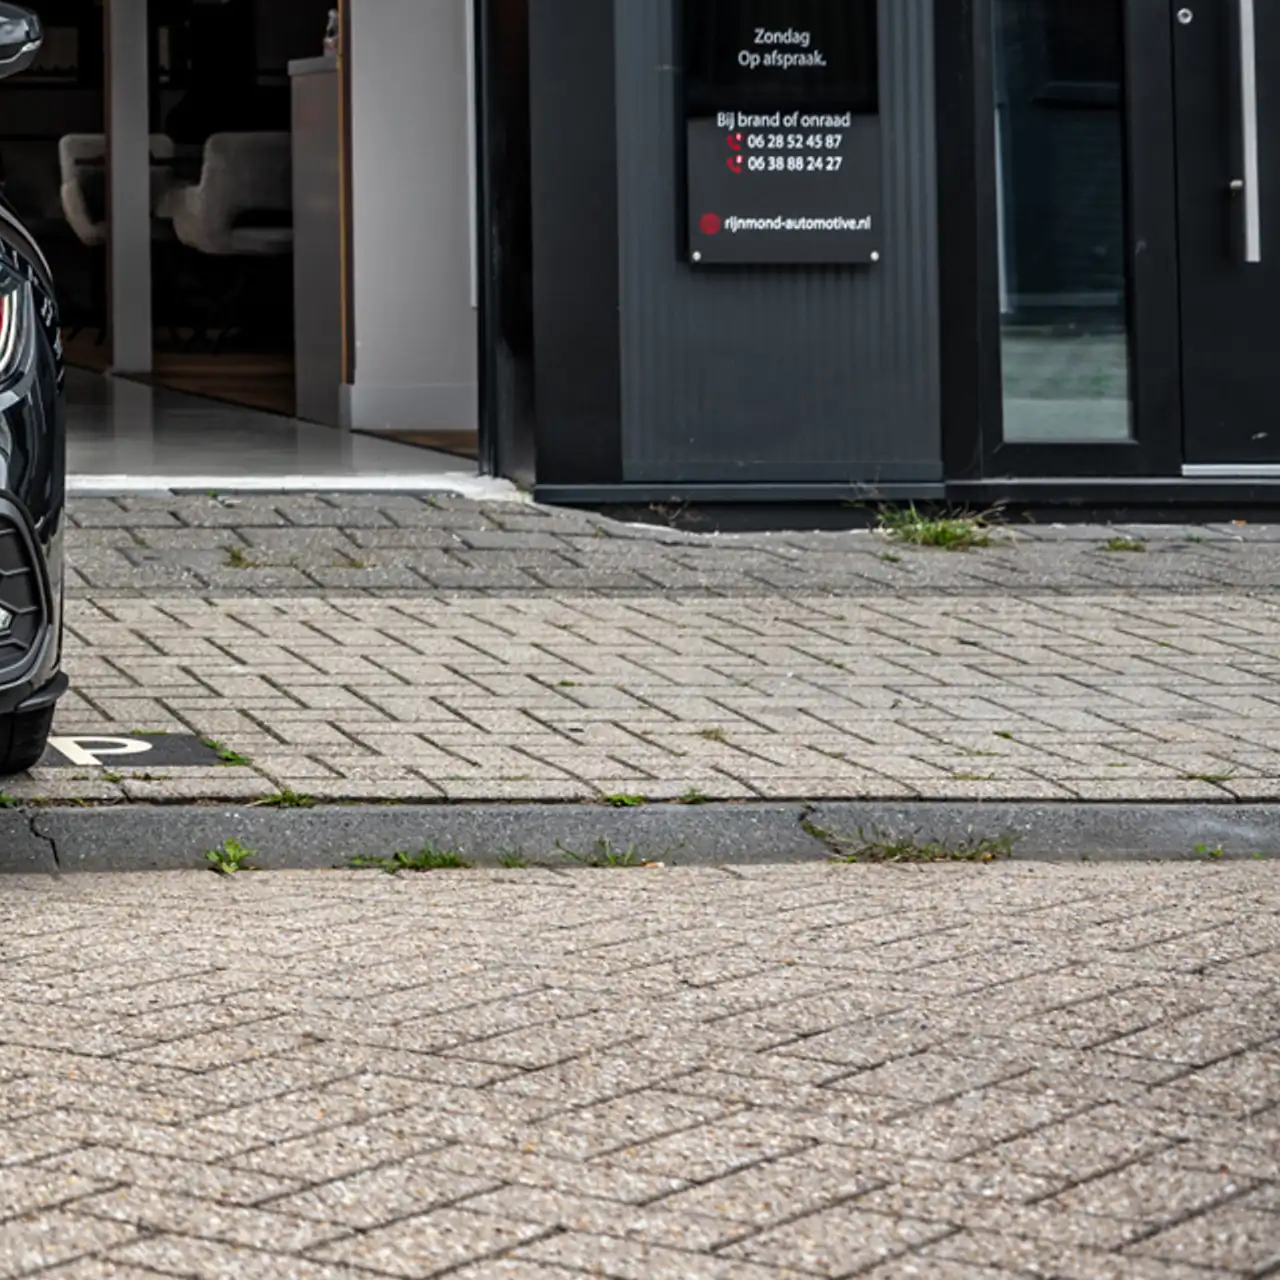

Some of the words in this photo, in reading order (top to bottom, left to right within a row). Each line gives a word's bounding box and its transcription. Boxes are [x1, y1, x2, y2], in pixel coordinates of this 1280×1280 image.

[753, 28, 810, 47] Zondag
[738, 51, 760, 69] Op
[763, 50, 827, 69] afspraak.
[717, 111, 735, 130] Bij
[738, 111, 780, 128] brand
[783, 111, 799, 128] of
[801, 111, 851, 127] onraad
[747, 134, 765, 149] 06
[768, 134, 784, 149] 28
[786, 134, 803, 149] 52
[806, 134, 822, 149] 45
[825, 134, 842, 149] 87
[747, 156, 765, 171] 06
[768, 156, 784, 171] 38
[787, 156, 804, 171] 88
[806, 156, 823, 171] 24
[825, 156, 842, 171] 27
[724, 215, 871, 233] rijnmond-automotive.nl
[47, 736, 152, 765] P
